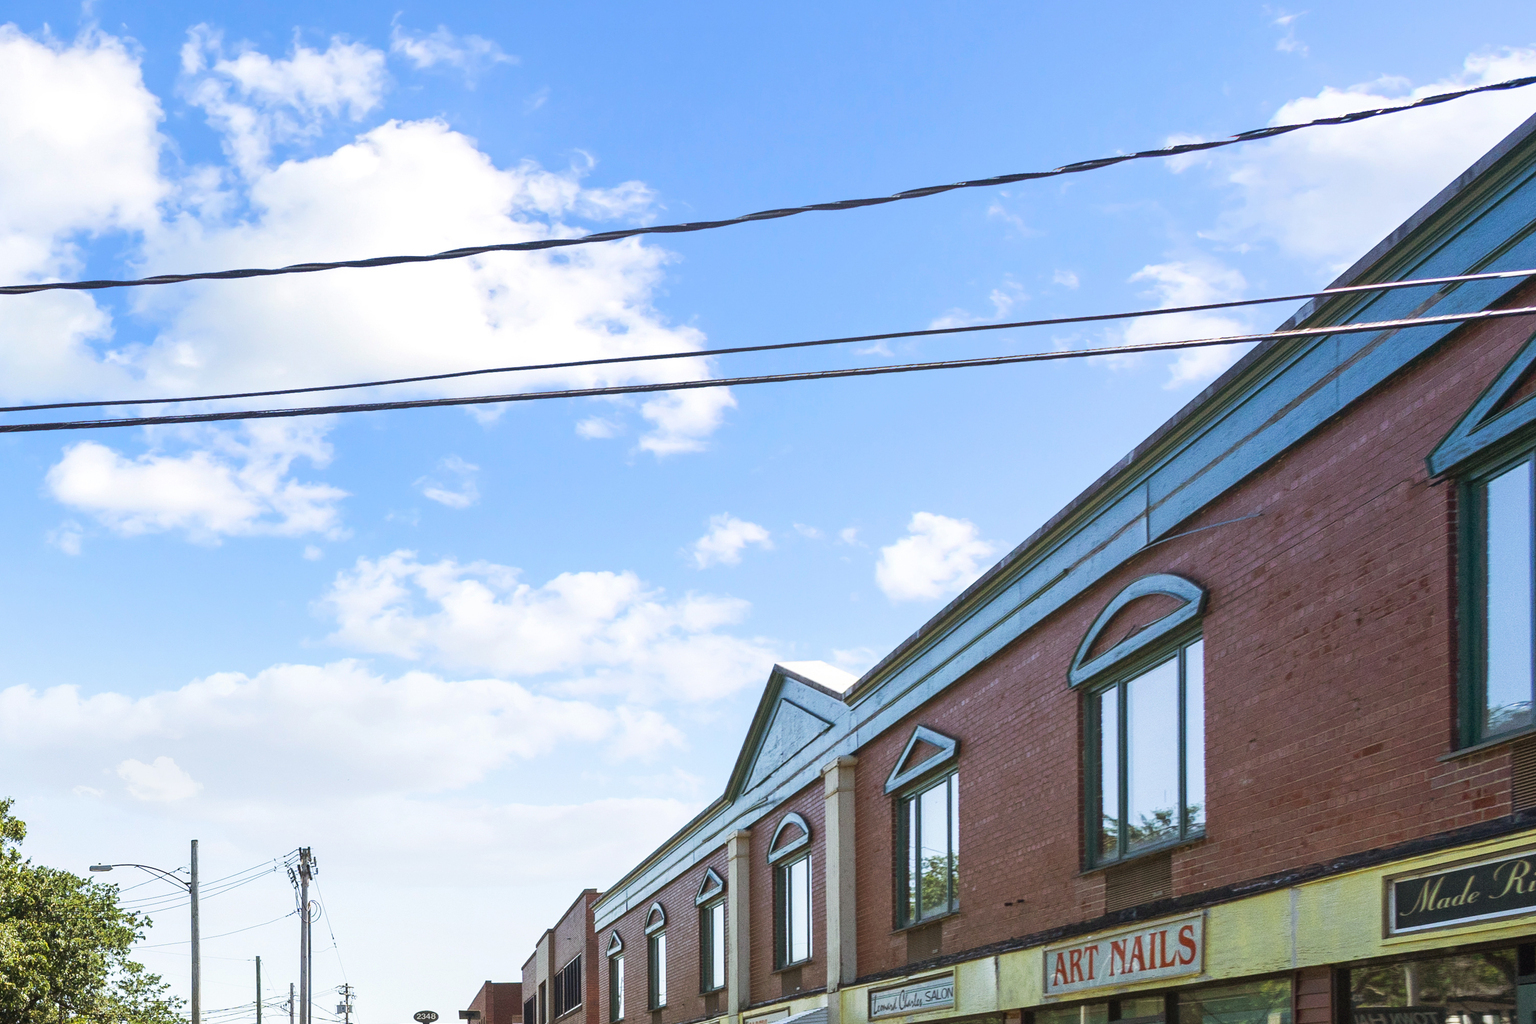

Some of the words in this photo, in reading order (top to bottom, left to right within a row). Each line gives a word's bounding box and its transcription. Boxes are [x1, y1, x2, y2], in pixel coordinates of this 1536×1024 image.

[1399, 875, 1480, 916] Made
[1052, 945, 1099, 986] ART
[1109, 925, 1197, 977] NAILS
[925, 986, 954, 1002] SALON
